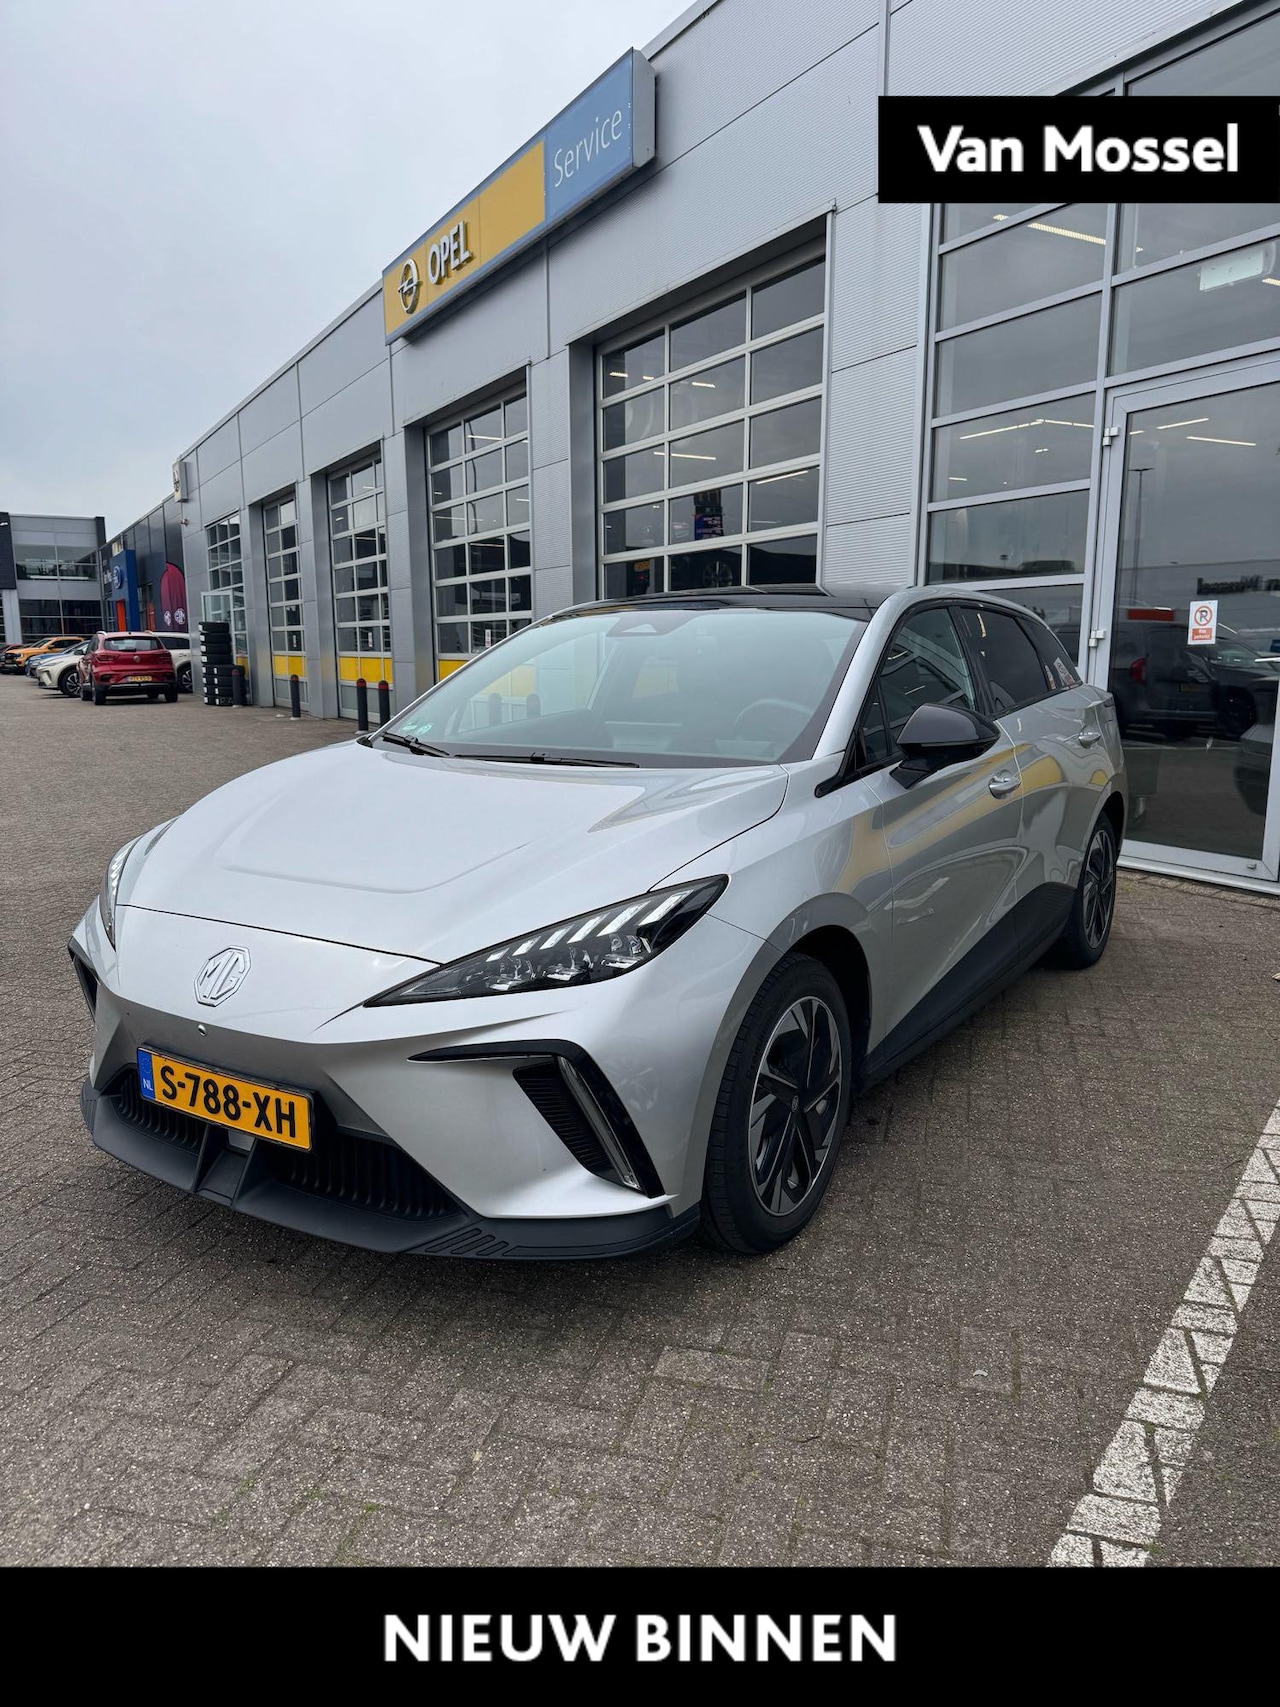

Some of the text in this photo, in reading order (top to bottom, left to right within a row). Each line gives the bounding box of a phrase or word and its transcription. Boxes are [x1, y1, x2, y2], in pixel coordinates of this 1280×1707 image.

[428, 109, 623, 286] OPEL Service
[197, 948, 248, 1004] MG
[143, 1078, 153, 1091] NL
[160, 1065, 296, 1138] S-788-XH
